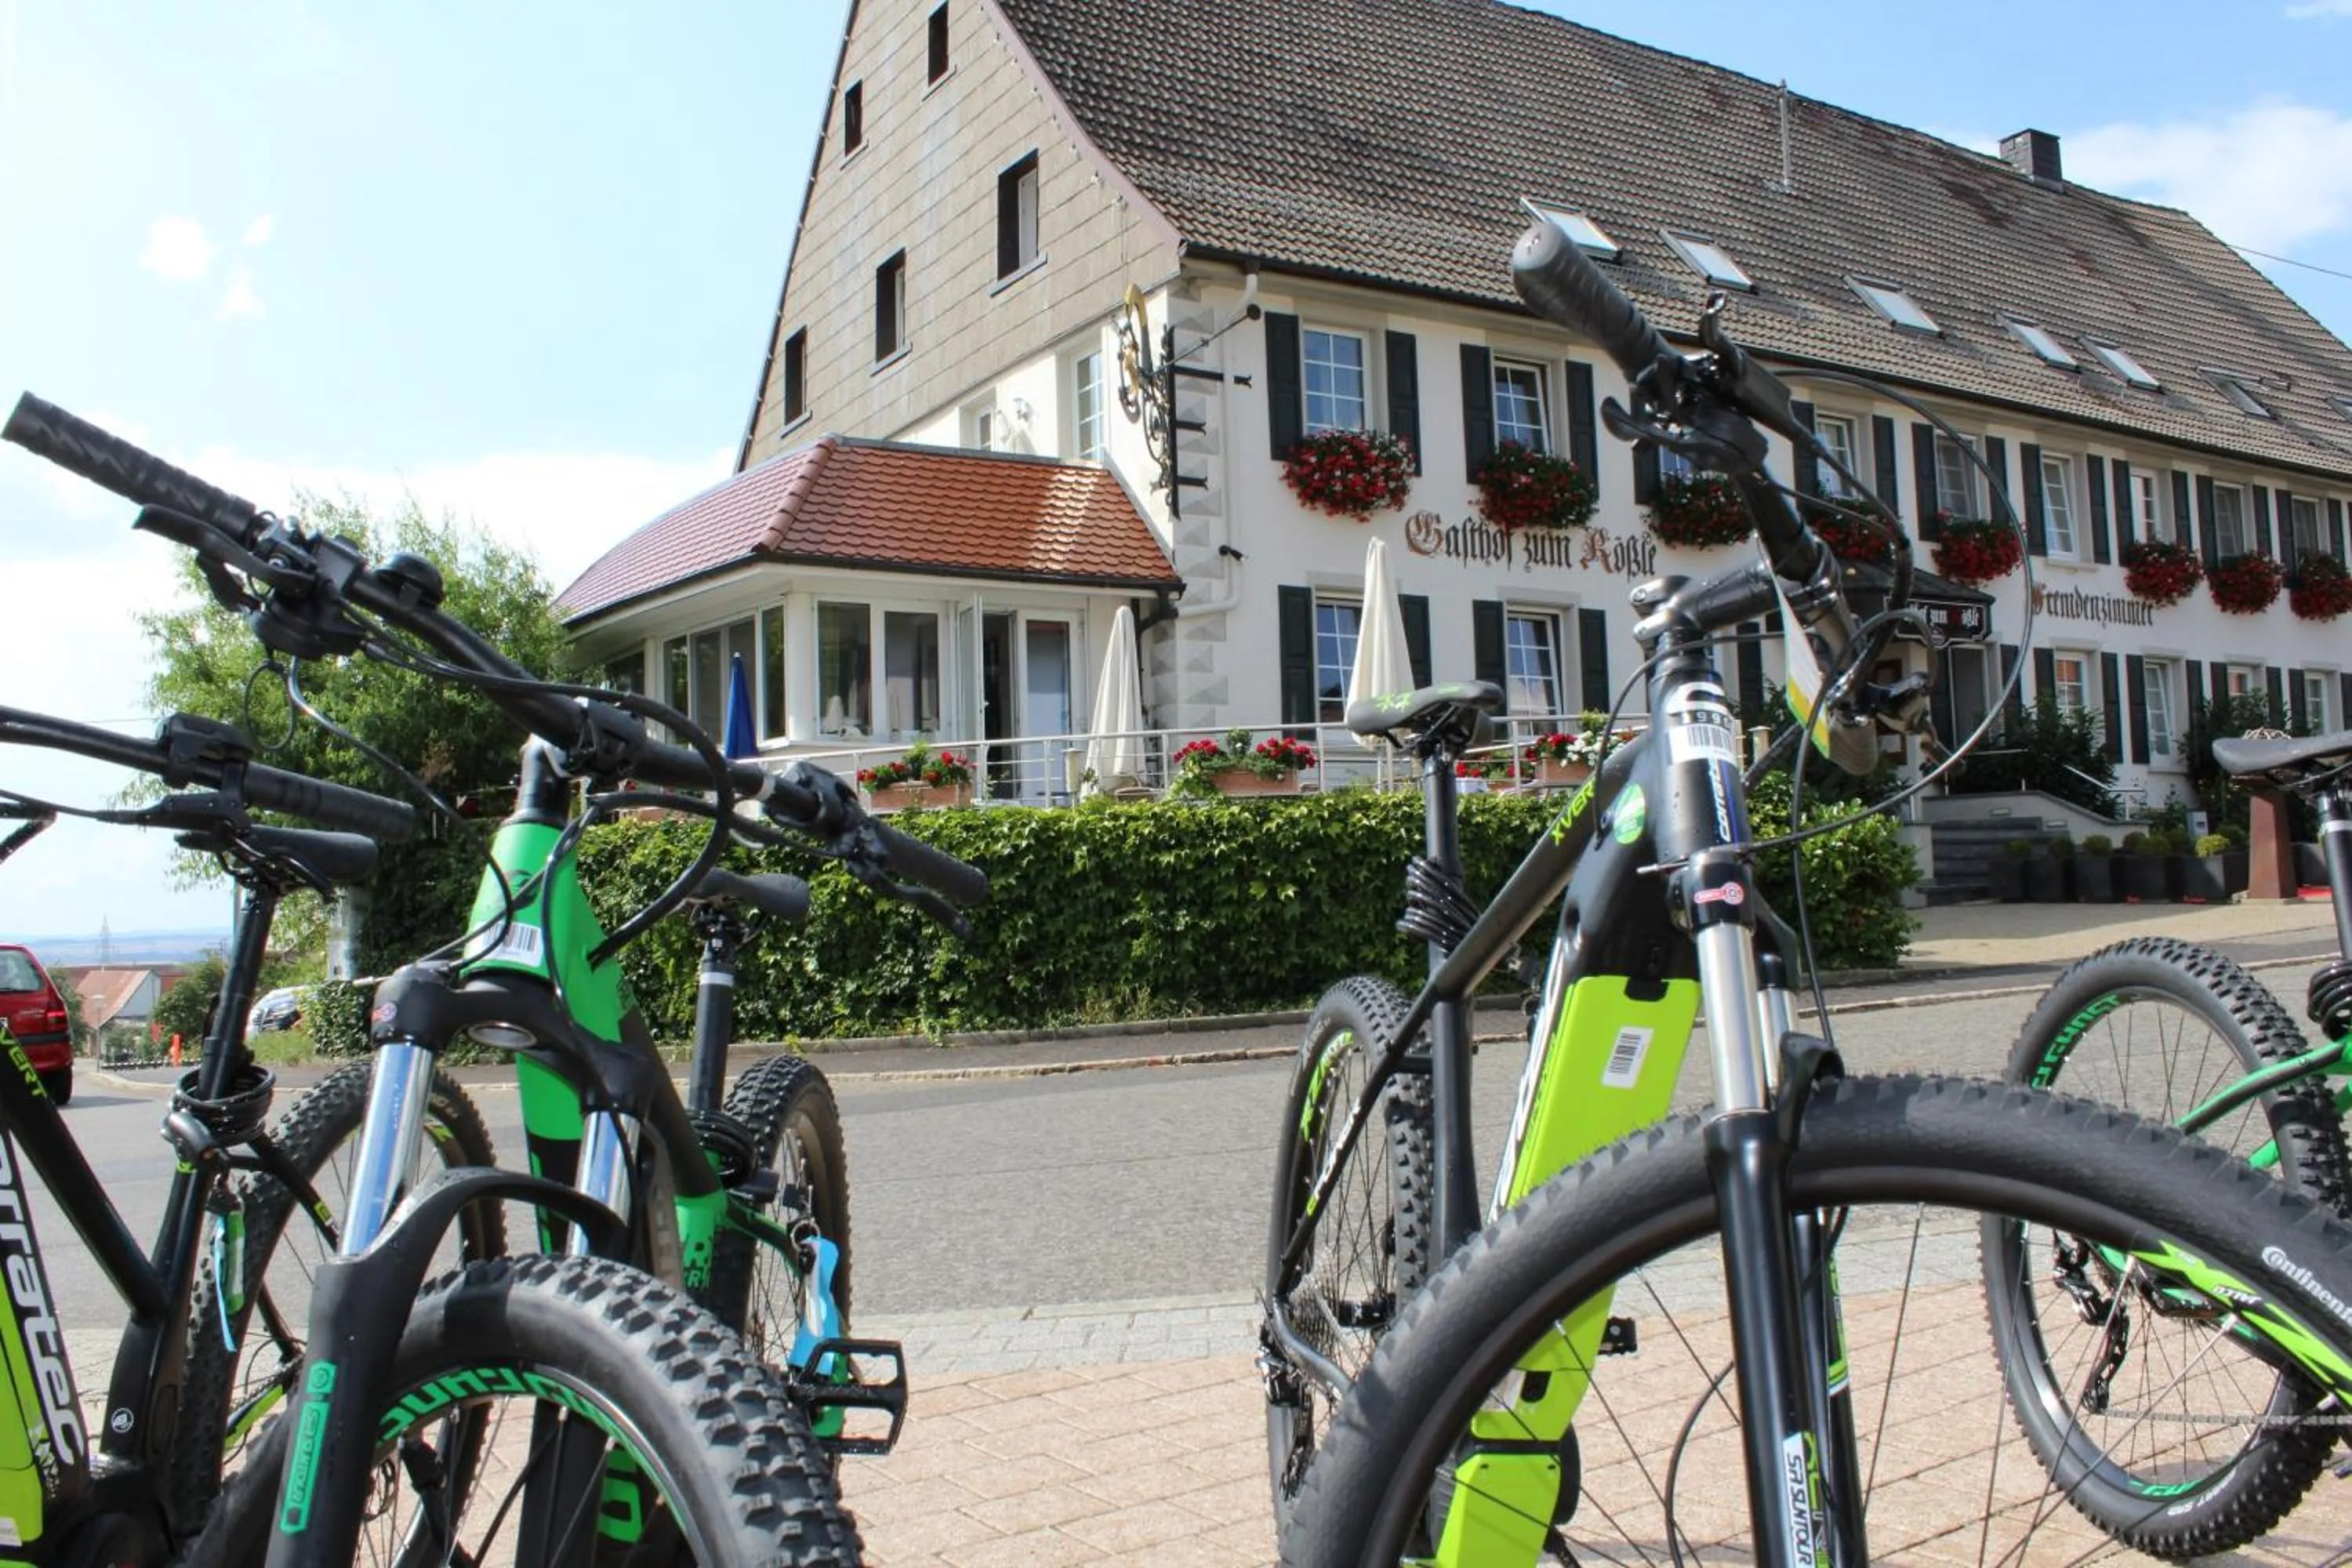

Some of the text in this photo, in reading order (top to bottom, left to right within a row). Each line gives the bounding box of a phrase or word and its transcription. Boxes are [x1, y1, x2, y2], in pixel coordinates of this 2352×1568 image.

[1404, 510, 1657, 583] Gasthof zum Rößle
[1552, 777, 1595, 847] XVER
[2262, 1246, 2352, 1327] Continent
[1790, 1486, 1813, 1566] SUNTOUR
